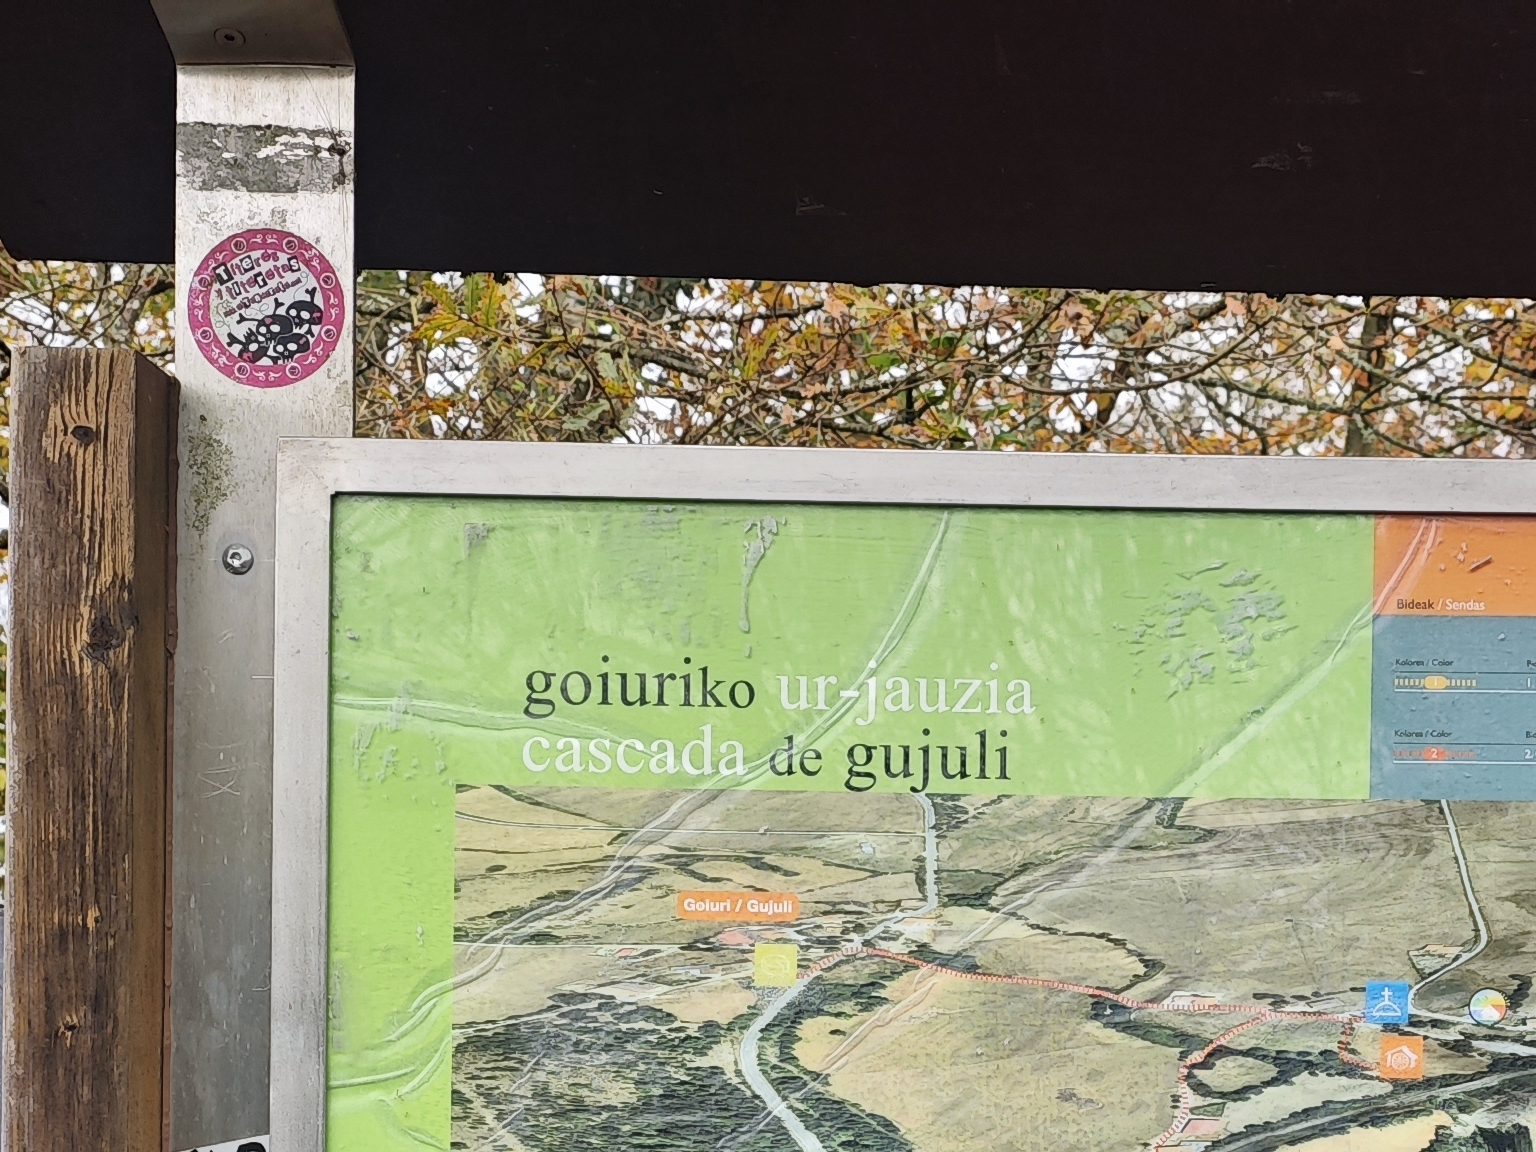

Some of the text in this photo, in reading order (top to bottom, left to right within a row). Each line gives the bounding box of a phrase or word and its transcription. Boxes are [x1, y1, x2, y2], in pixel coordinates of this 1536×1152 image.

[1397, 599, 1435, 610] Bideak
[1445, 600, 1485, 611] Sendas
[523, 655, 1036, 725] goiuriko ur-jauzia
[521, 724, 1011, 794] cascada de gujuli
[1431, 748, 1437, 758] 2
[683, 898, 792, 915] Goiuri / Gujuli
